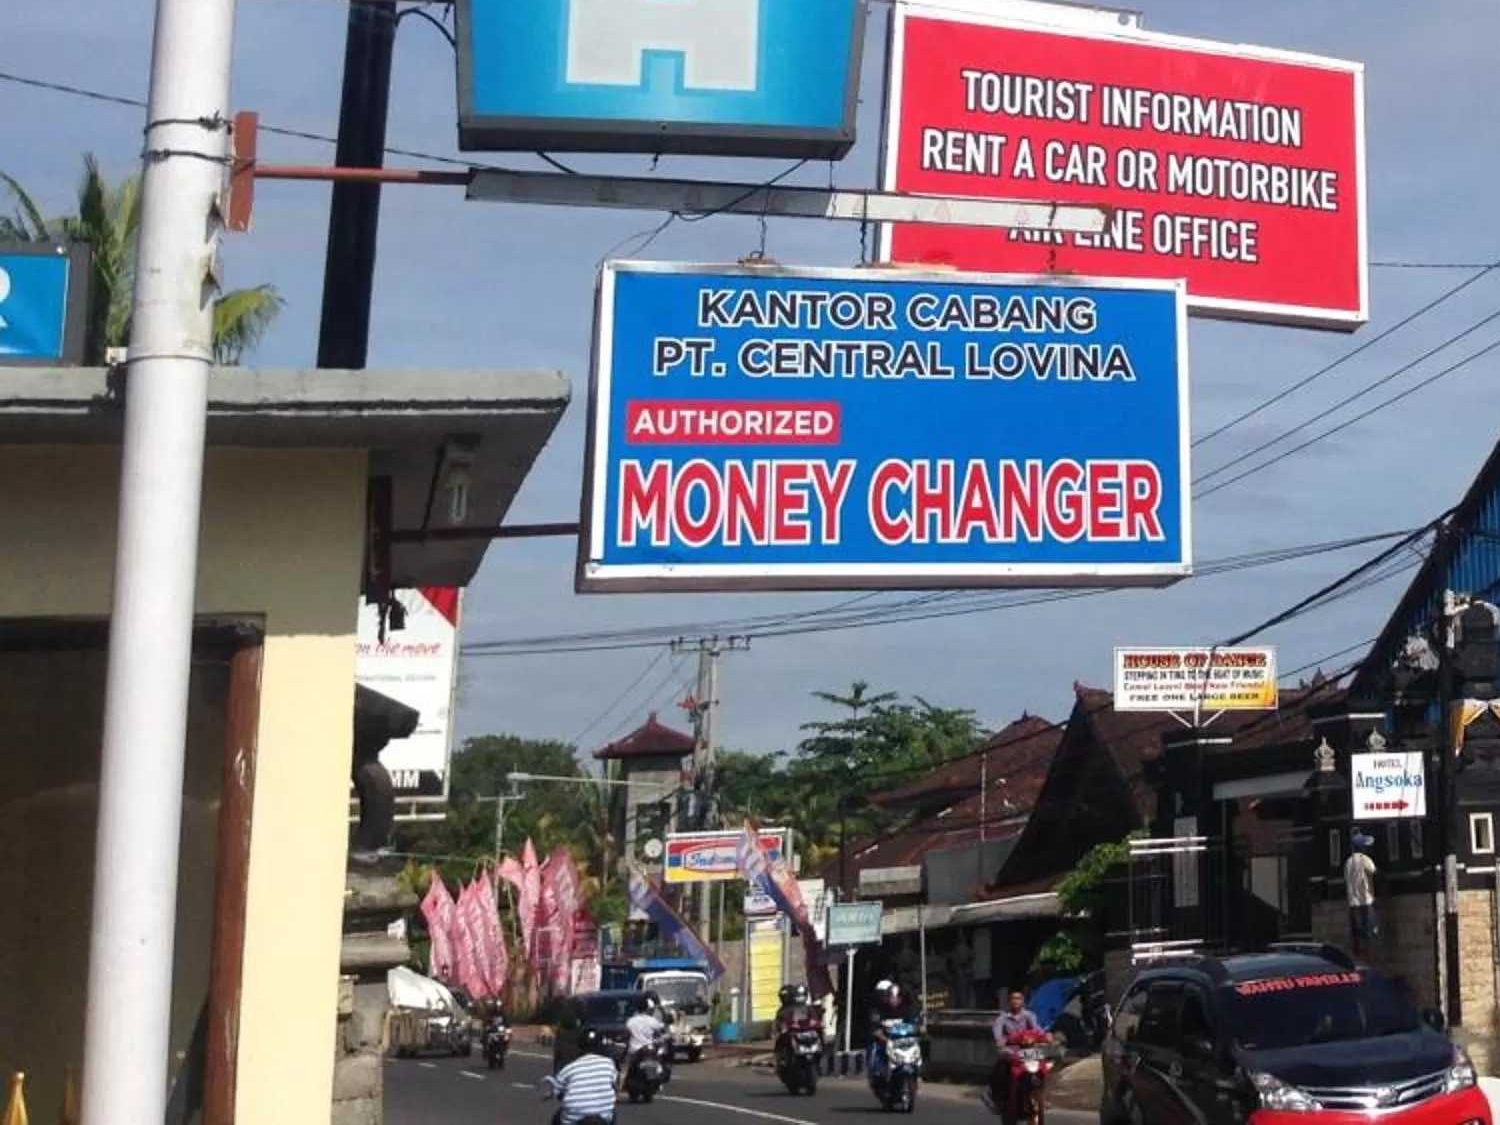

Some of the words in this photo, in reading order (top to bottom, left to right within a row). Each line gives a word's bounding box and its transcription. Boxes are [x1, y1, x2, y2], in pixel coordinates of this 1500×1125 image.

[961, 70, 1093, 124] TOURIST
[1102, 85, 1302, 148] INFORMATION
[921, 128, 1006, 176] RENT
[1013, 140, 1036, 179] A
[1045, 141, 1107, 187] CAR
[1117, 150, 1158, 192] OR
[1167, 156, 1338, 211] MOTORBIKE
[1153, 214, 1258, 263] OFFICE
[699, 289, 897, 331] KANTOR
[906, 294, 1097, 333] CABANG
[653, 339, 727, 377] PT.
[738, 340, 955, 379] CENTRAL
[966, 344, 1136, 382] LOVINA
[632, 408, 834, 437] AUTHORIZED
[616, 459, 857, 548] MONEY
[868, 459, 1165, 547] CHANGER
[1123, 654, 1181, 668] HOUSE
[1184, 653, 1208, 668] OF
[1129, 693, 1158, 702] FREE
[1162, 693, 1186, 701] ONE
[1355, 769, 1422, 794] Angsoka
